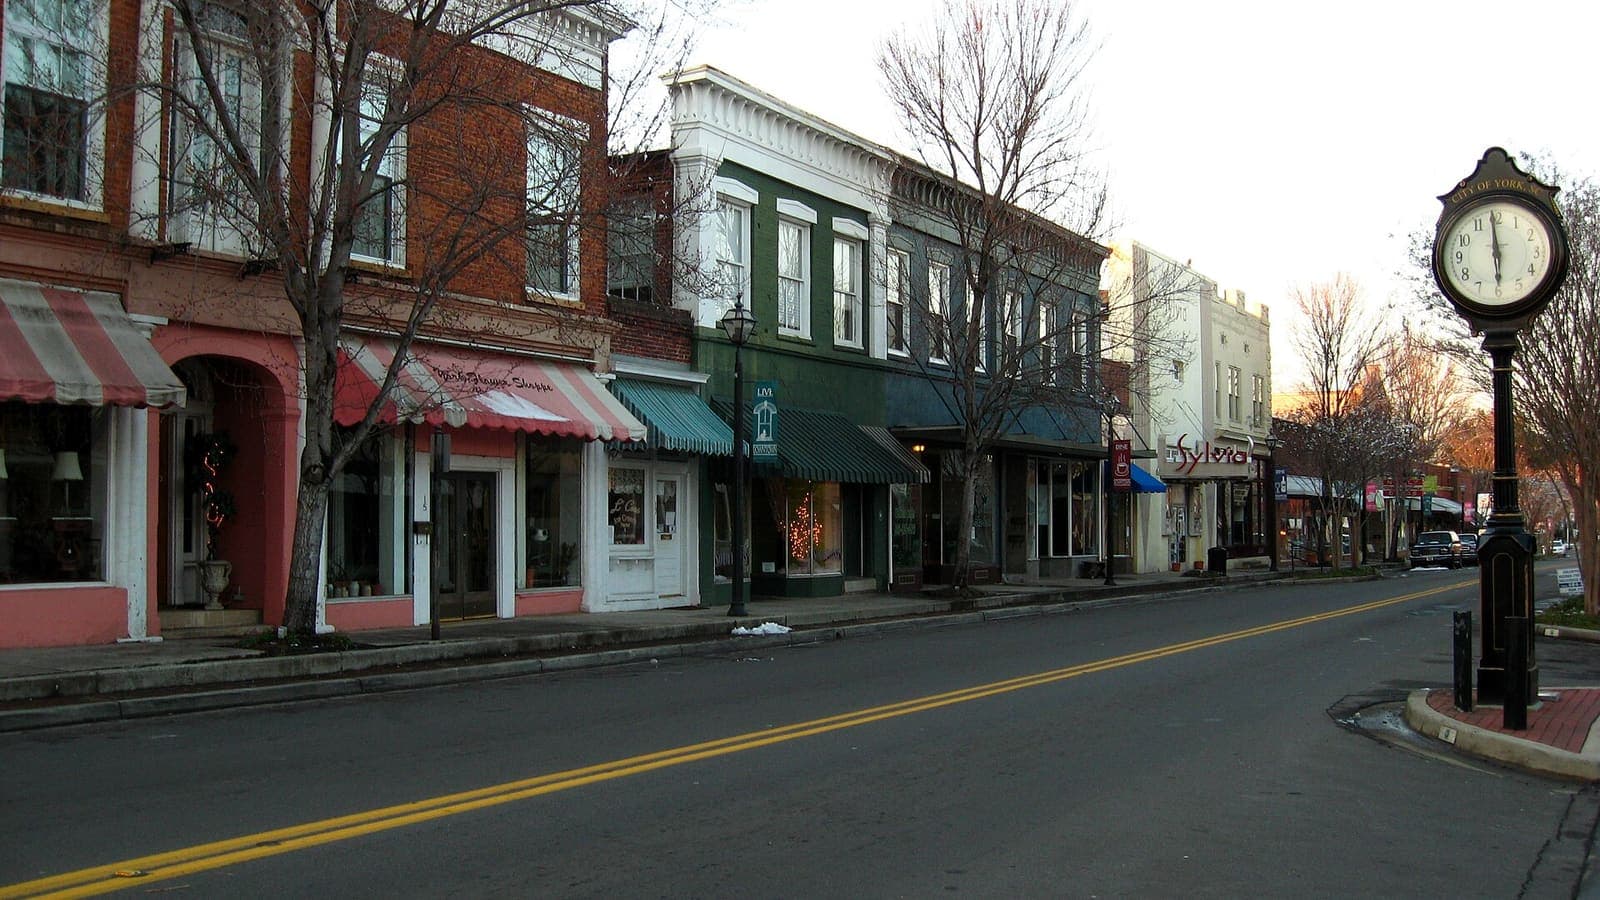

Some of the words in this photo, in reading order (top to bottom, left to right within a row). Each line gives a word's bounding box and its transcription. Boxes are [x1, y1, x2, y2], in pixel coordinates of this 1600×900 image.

[1452, 185, 1474, 203] CITY
[1477, 180, 1489, 191] OF
[1494, 179, 1526, 191] YORK,
[1473, 218, 1483, 231] 11
[1459, 234, 1470, 247] 10
[1527, 228, 1534, 241] 2
[1456, 250, 1463, 264] 9
[1533, 247, 1540, 259] 3
[1461, 267, 1469, 281] 8
[1527, 263, 1535, 276] 4
[1475, 281, 1482, 294] 7
[1495, 285, 1502, 297] 6
[1514, 278, 1523, 291] 5
[757, 388, 773, 397] LIVE
